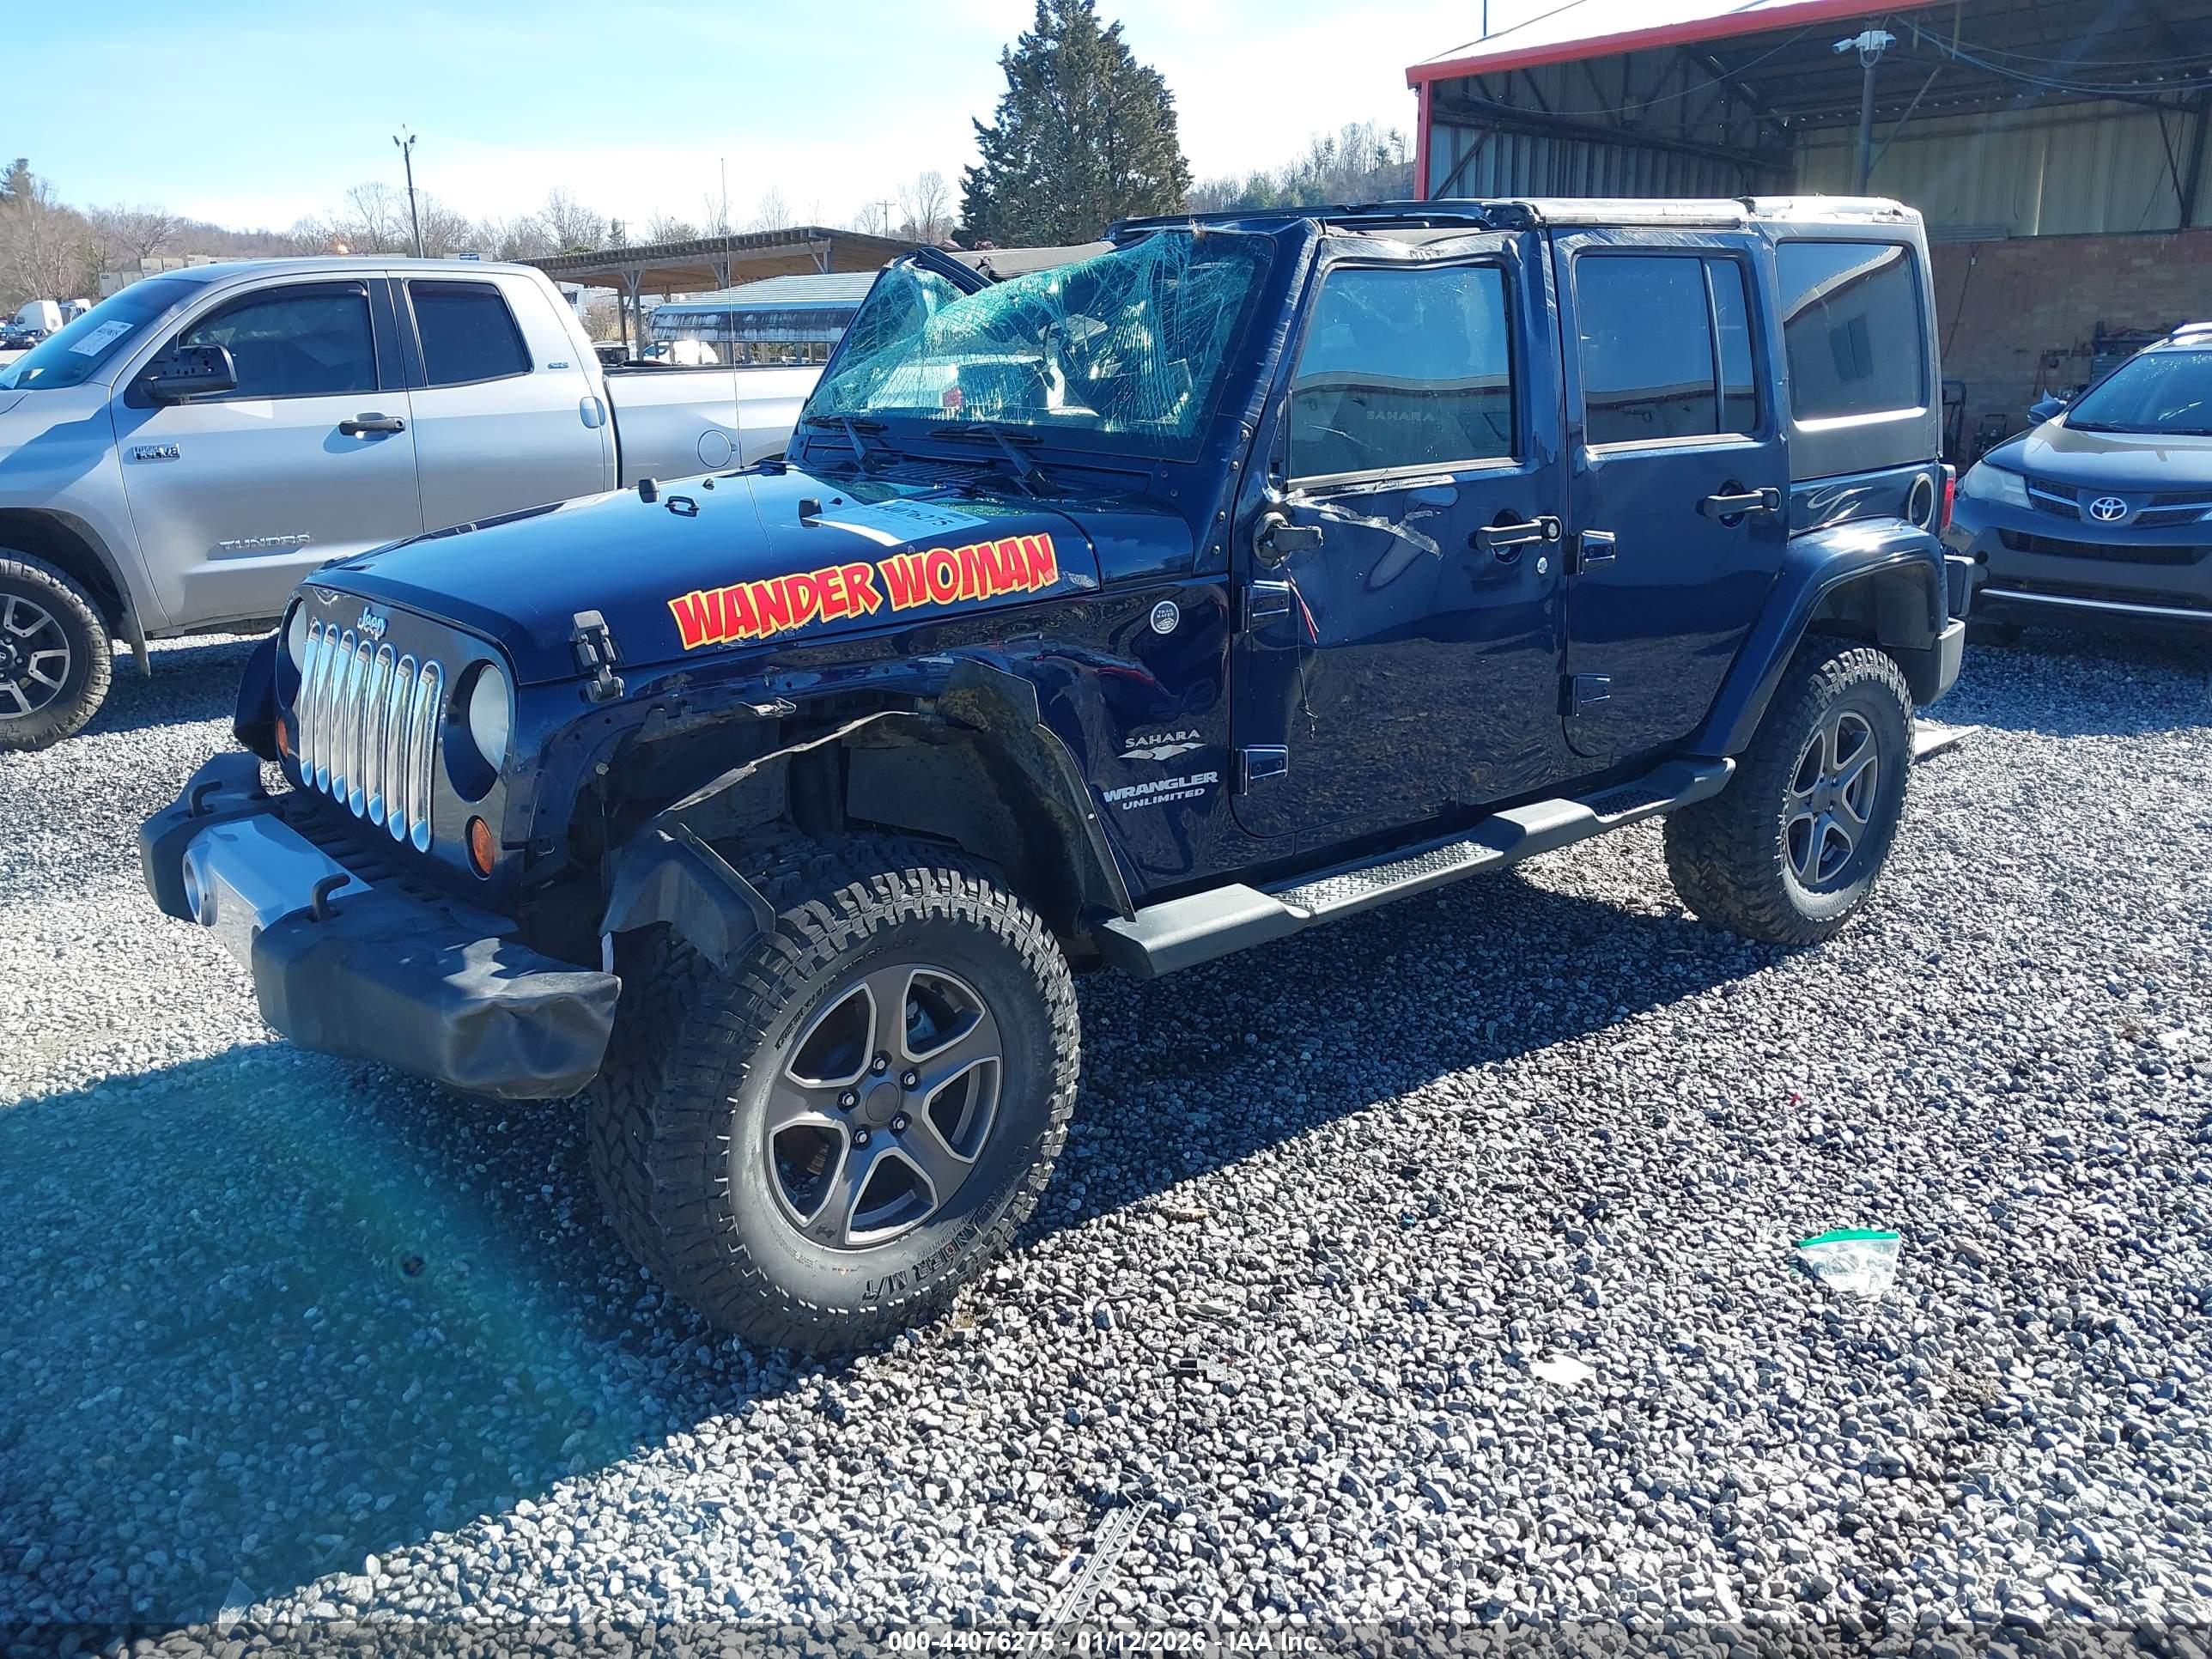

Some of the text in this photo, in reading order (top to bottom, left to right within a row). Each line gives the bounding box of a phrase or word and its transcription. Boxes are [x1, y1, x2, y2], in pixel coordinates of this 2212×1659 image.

[1366, 410, 1436, 422] SAHARA
[219, 534, 310, 550] TUNDRA
[667, 532, 1060, 651] WANDER WOMAN
[356, 606, 387, 641] Jeep
[1125, 729, 1200, 749] SAHARA
[1103, 771, 1218, 803] WRANGLER
[1122, 787, 1206, 811] UNLIMITED
[862, 1269, 908, 1301] M/T
